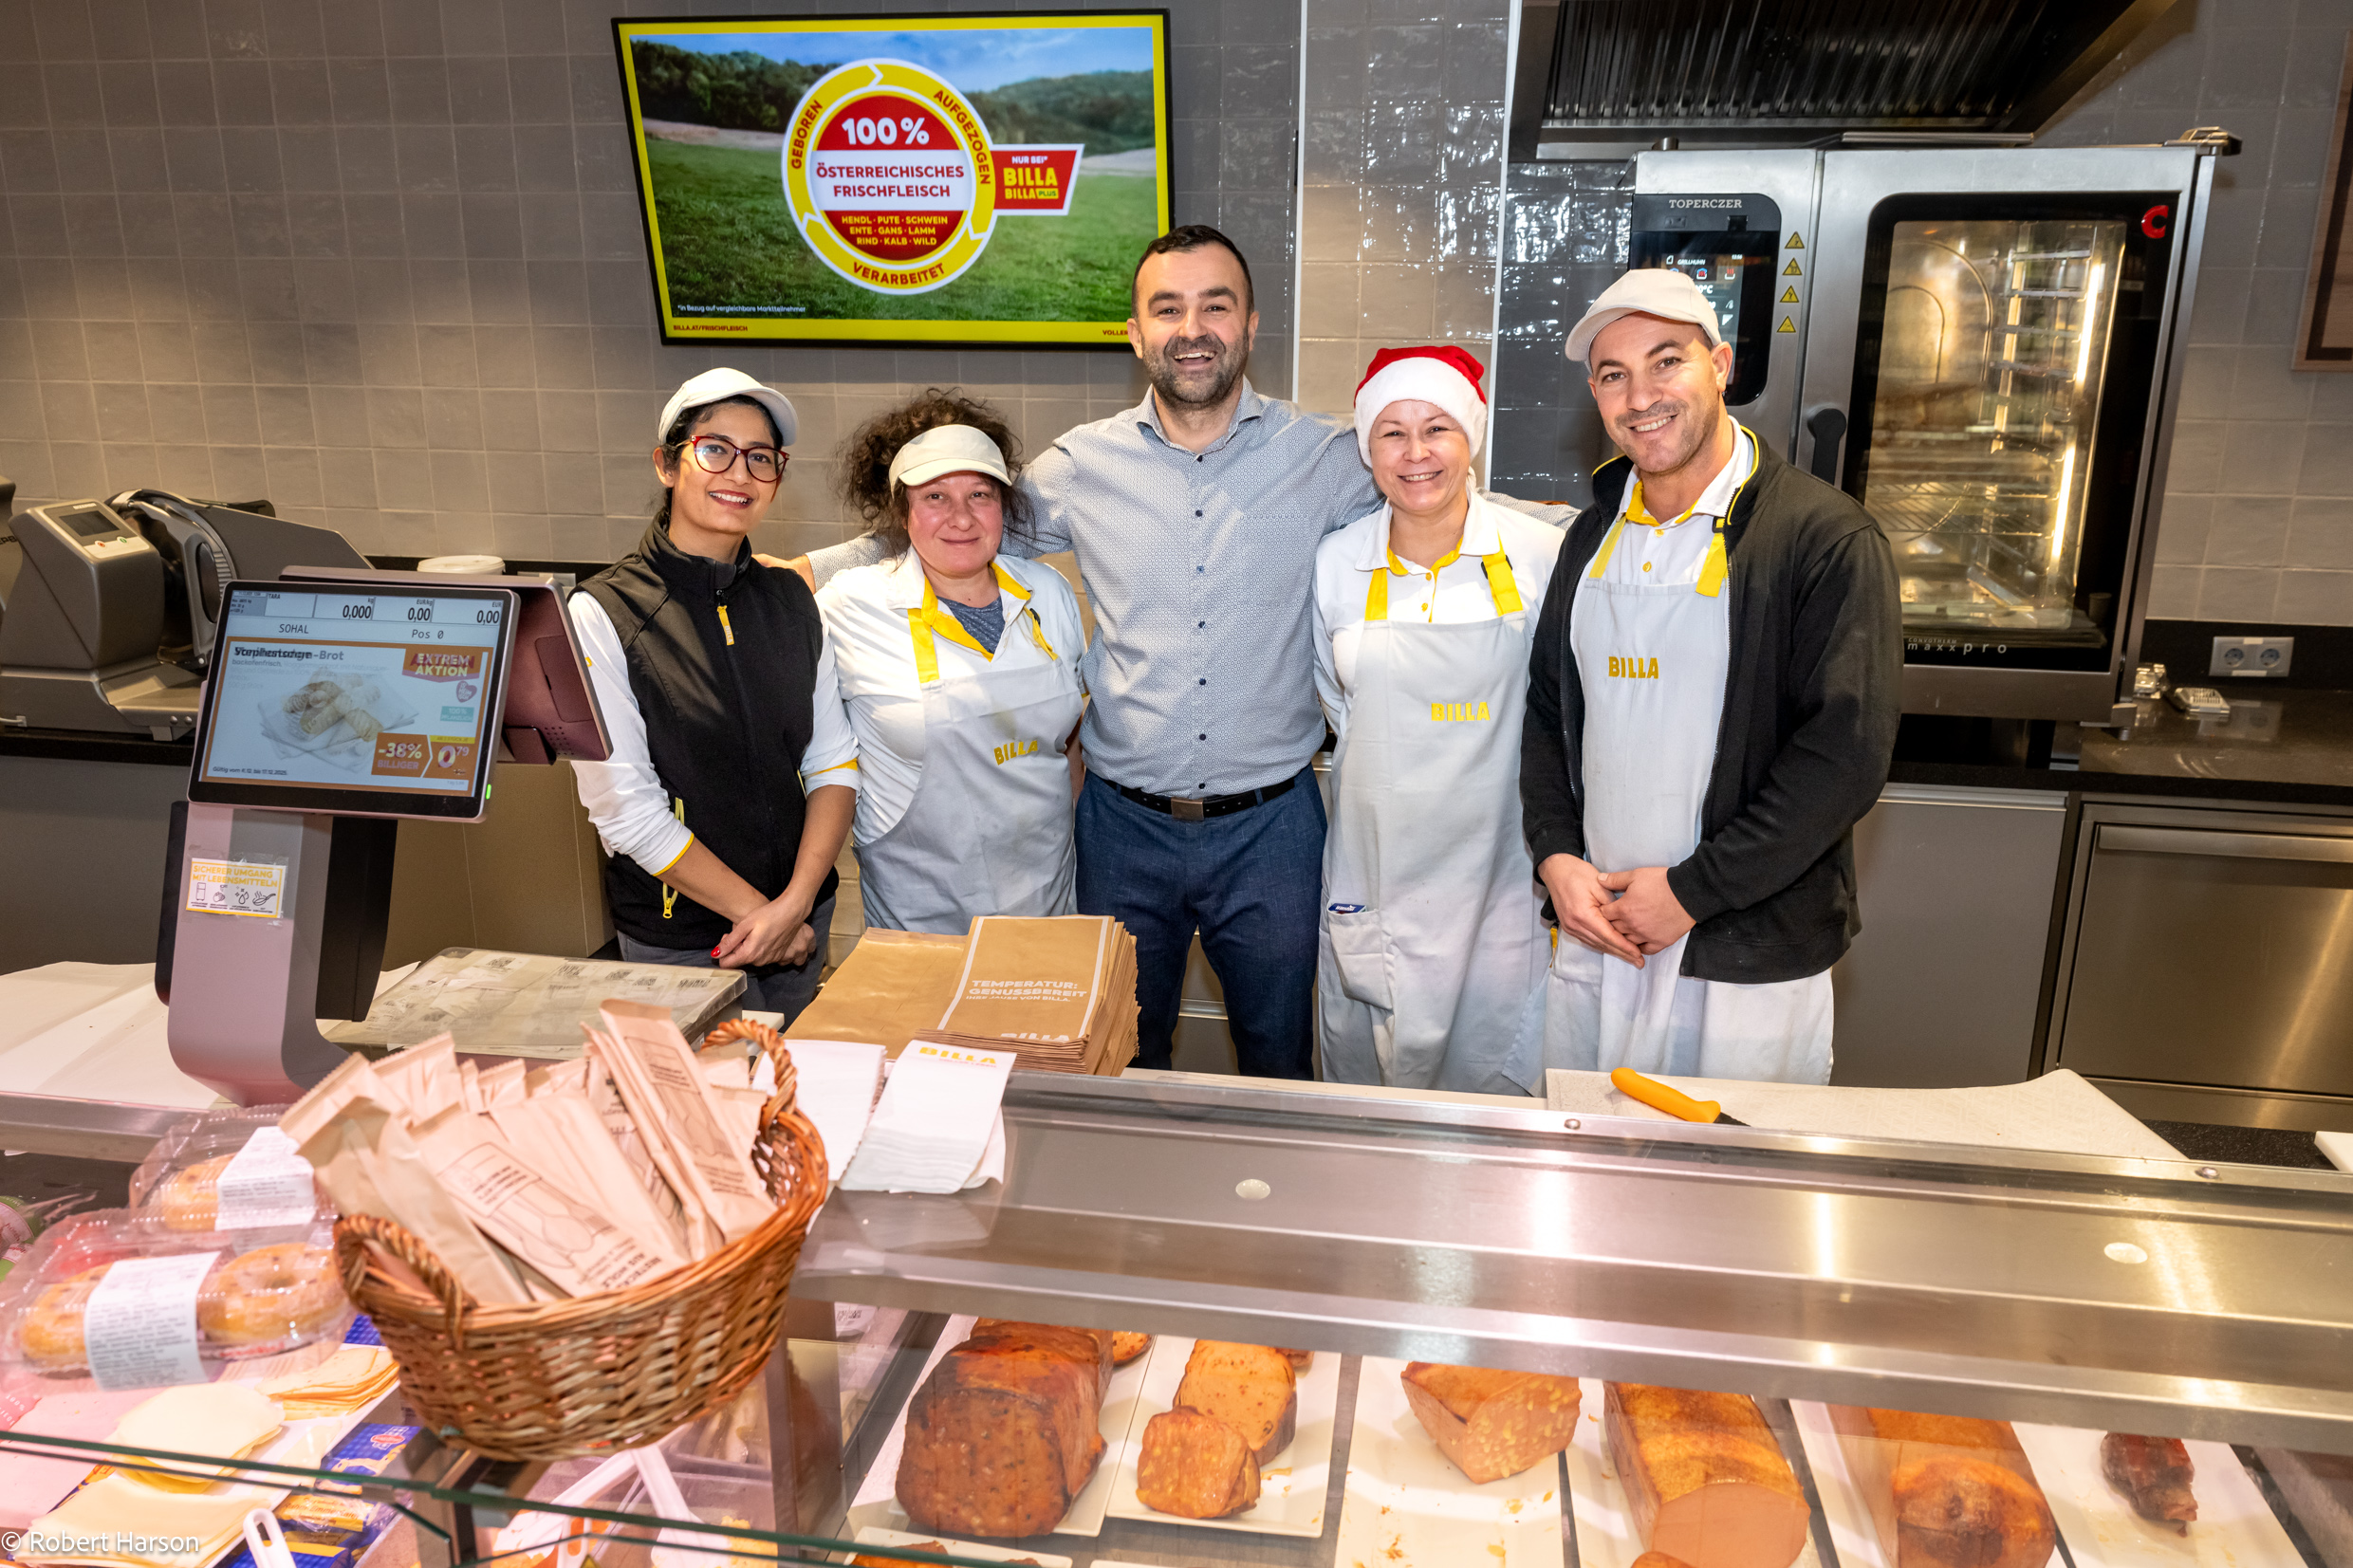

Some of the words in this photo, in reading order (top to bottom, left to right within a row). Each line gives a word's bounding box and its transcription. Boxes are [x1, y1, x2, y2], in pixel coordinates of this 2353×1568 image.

[791, 100, 824, 169] GEBOREN
[934, 89, 991, 185] AUFGEZOGEN
[1011, 156, 1029, 164] NUR
[816, 162, 965, 178] ÖSTERREICHISCHES
[1003, 167, 1058, 186] BILLA
[833, 185, 951, 197] FRISCHFLEISCH
[1005, 188, 1036, 199] BILLA
[1669, 199, 1743, 209] TOPERCZER
[842, 215, 872, 225] HENDL
[878, 215, 900, 224] PUTE
[905, 215, 948, 225] SCHWEIN
[850, 227, 873, 235] ENTE
[878, 227, 902, 235] GANS
[908, 227, 936, 235] LAMM
[857, 237, 879, 246] RIND
[884, 237, 908, 246] KALB
[913, 237, 937, 246] WILD
[853, 261, 945, 286] VERARBEITET
[686, 304, 705, 313] Bezug
[716, 304, 756, 313] vergleichbare
[343, 605, 372, 619] 0,000
[408, 607, 431, 622] 0,00
[476, 610, 500, 625] 0,00
[279, 624, 308, 634] SOHAL
[412, 629, 431, 638] Pos
[417, 654, 470, 666] EXTREM
[415, 665, 468, 677] AKTION
[1608, 656, 1658, 679] BILLA
[1431, 702, 1491, 722] BILLA
[379, 743, 422, 759] -38%
[993, 740, 1038, 766] BILLA
[378, 760, 418, 769] BILLIGER
[194, 865, 232, 876] SICHERER
[233, 869, 273, 878] UMGANG
[208, 875, 277, 887] LEBENSMITTELN
[972, 980, 1078, 989] TEMPERATUR:
[969, 988, 1087, 998] GENUSSBEREIT
[919, 1046, 996, 1064] BILLA
